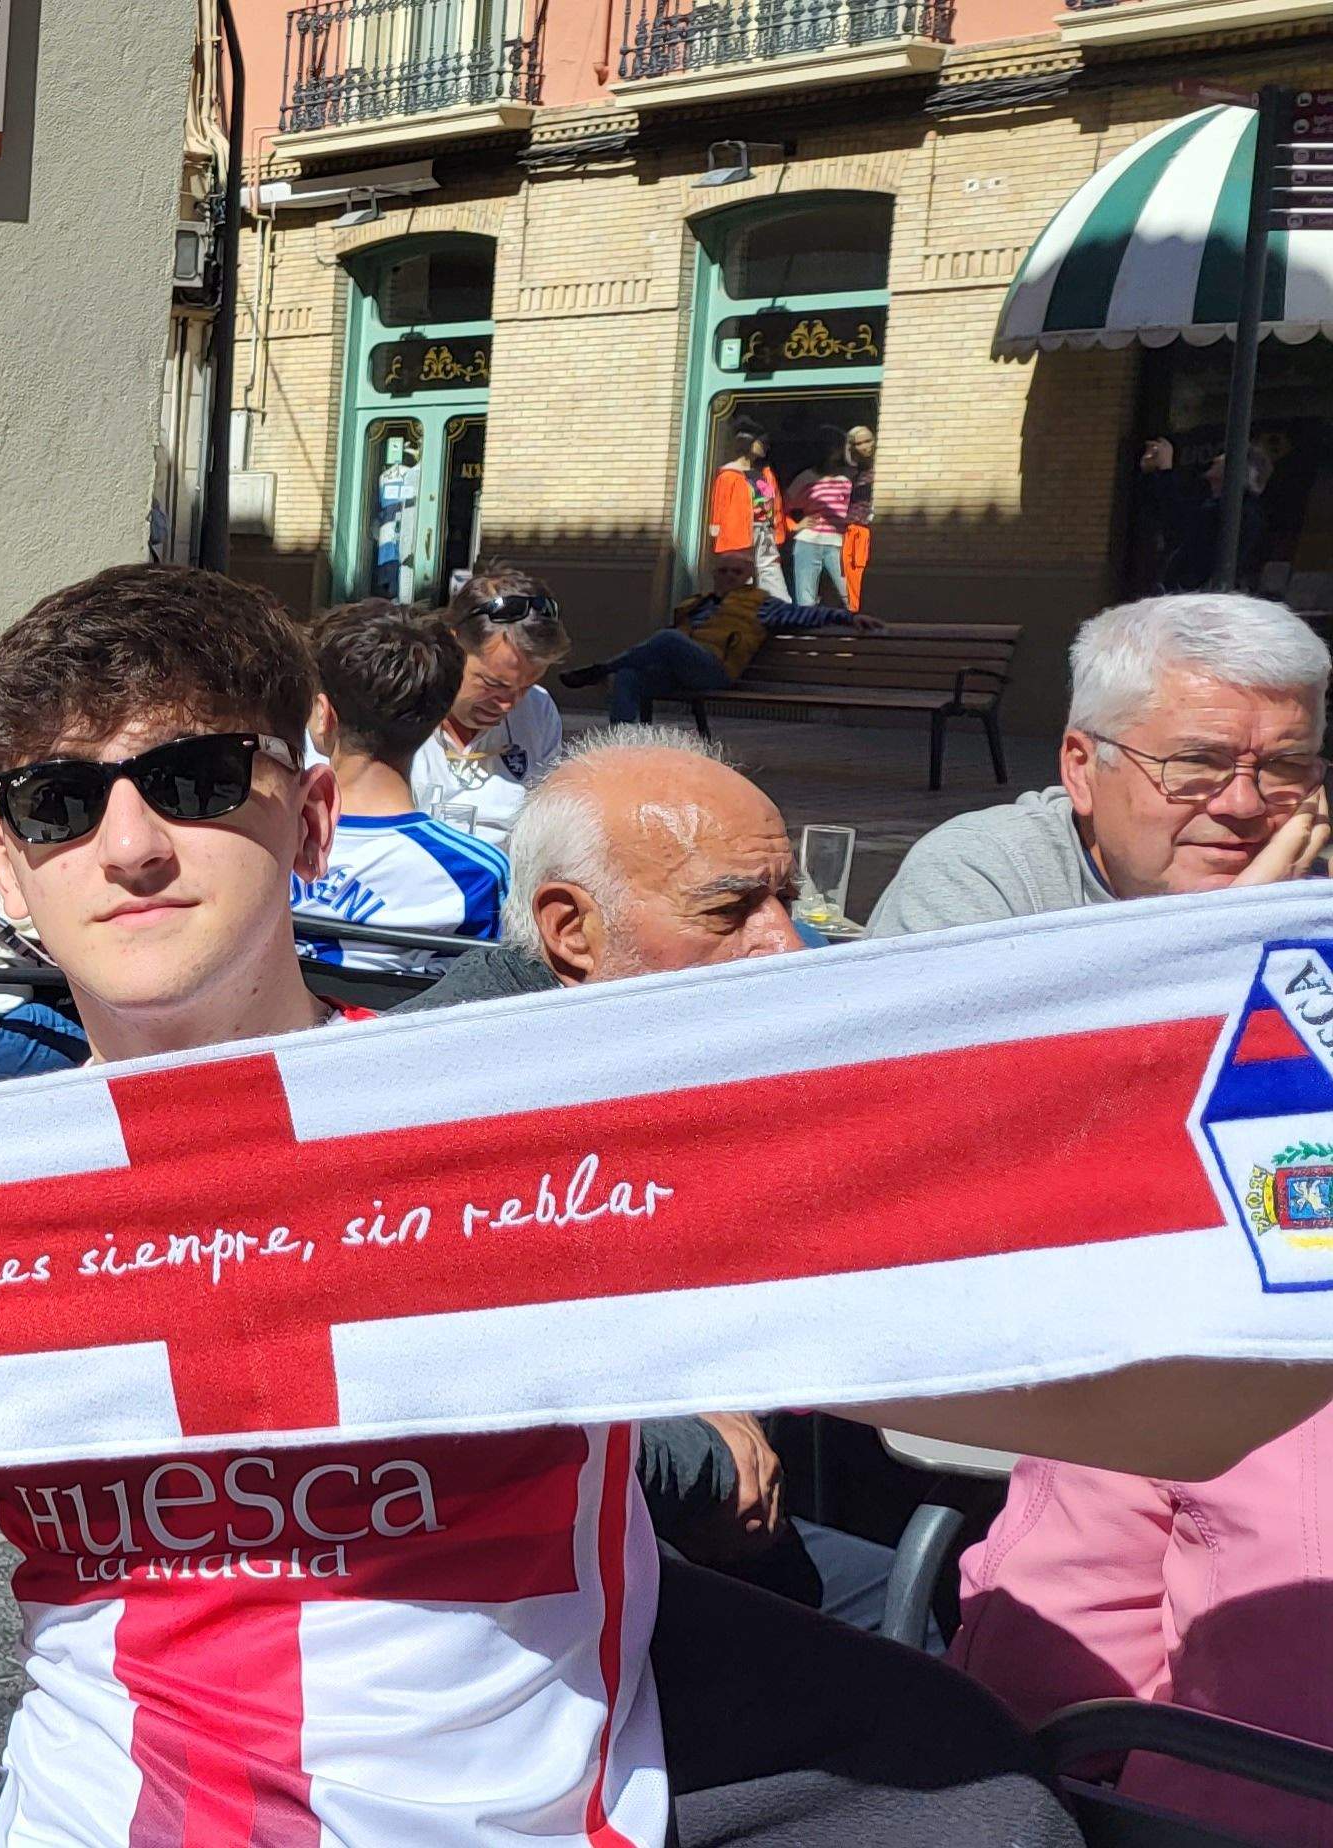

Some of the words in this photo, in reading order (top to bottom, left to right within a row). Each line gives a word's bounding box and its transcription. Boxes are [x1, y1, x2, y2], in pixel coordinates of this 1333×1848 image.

[77, 1226, 315, 1284] siempre,
[341, 1199, 432, 1248] sin
[461, 1153, 676, 1238] reblar
